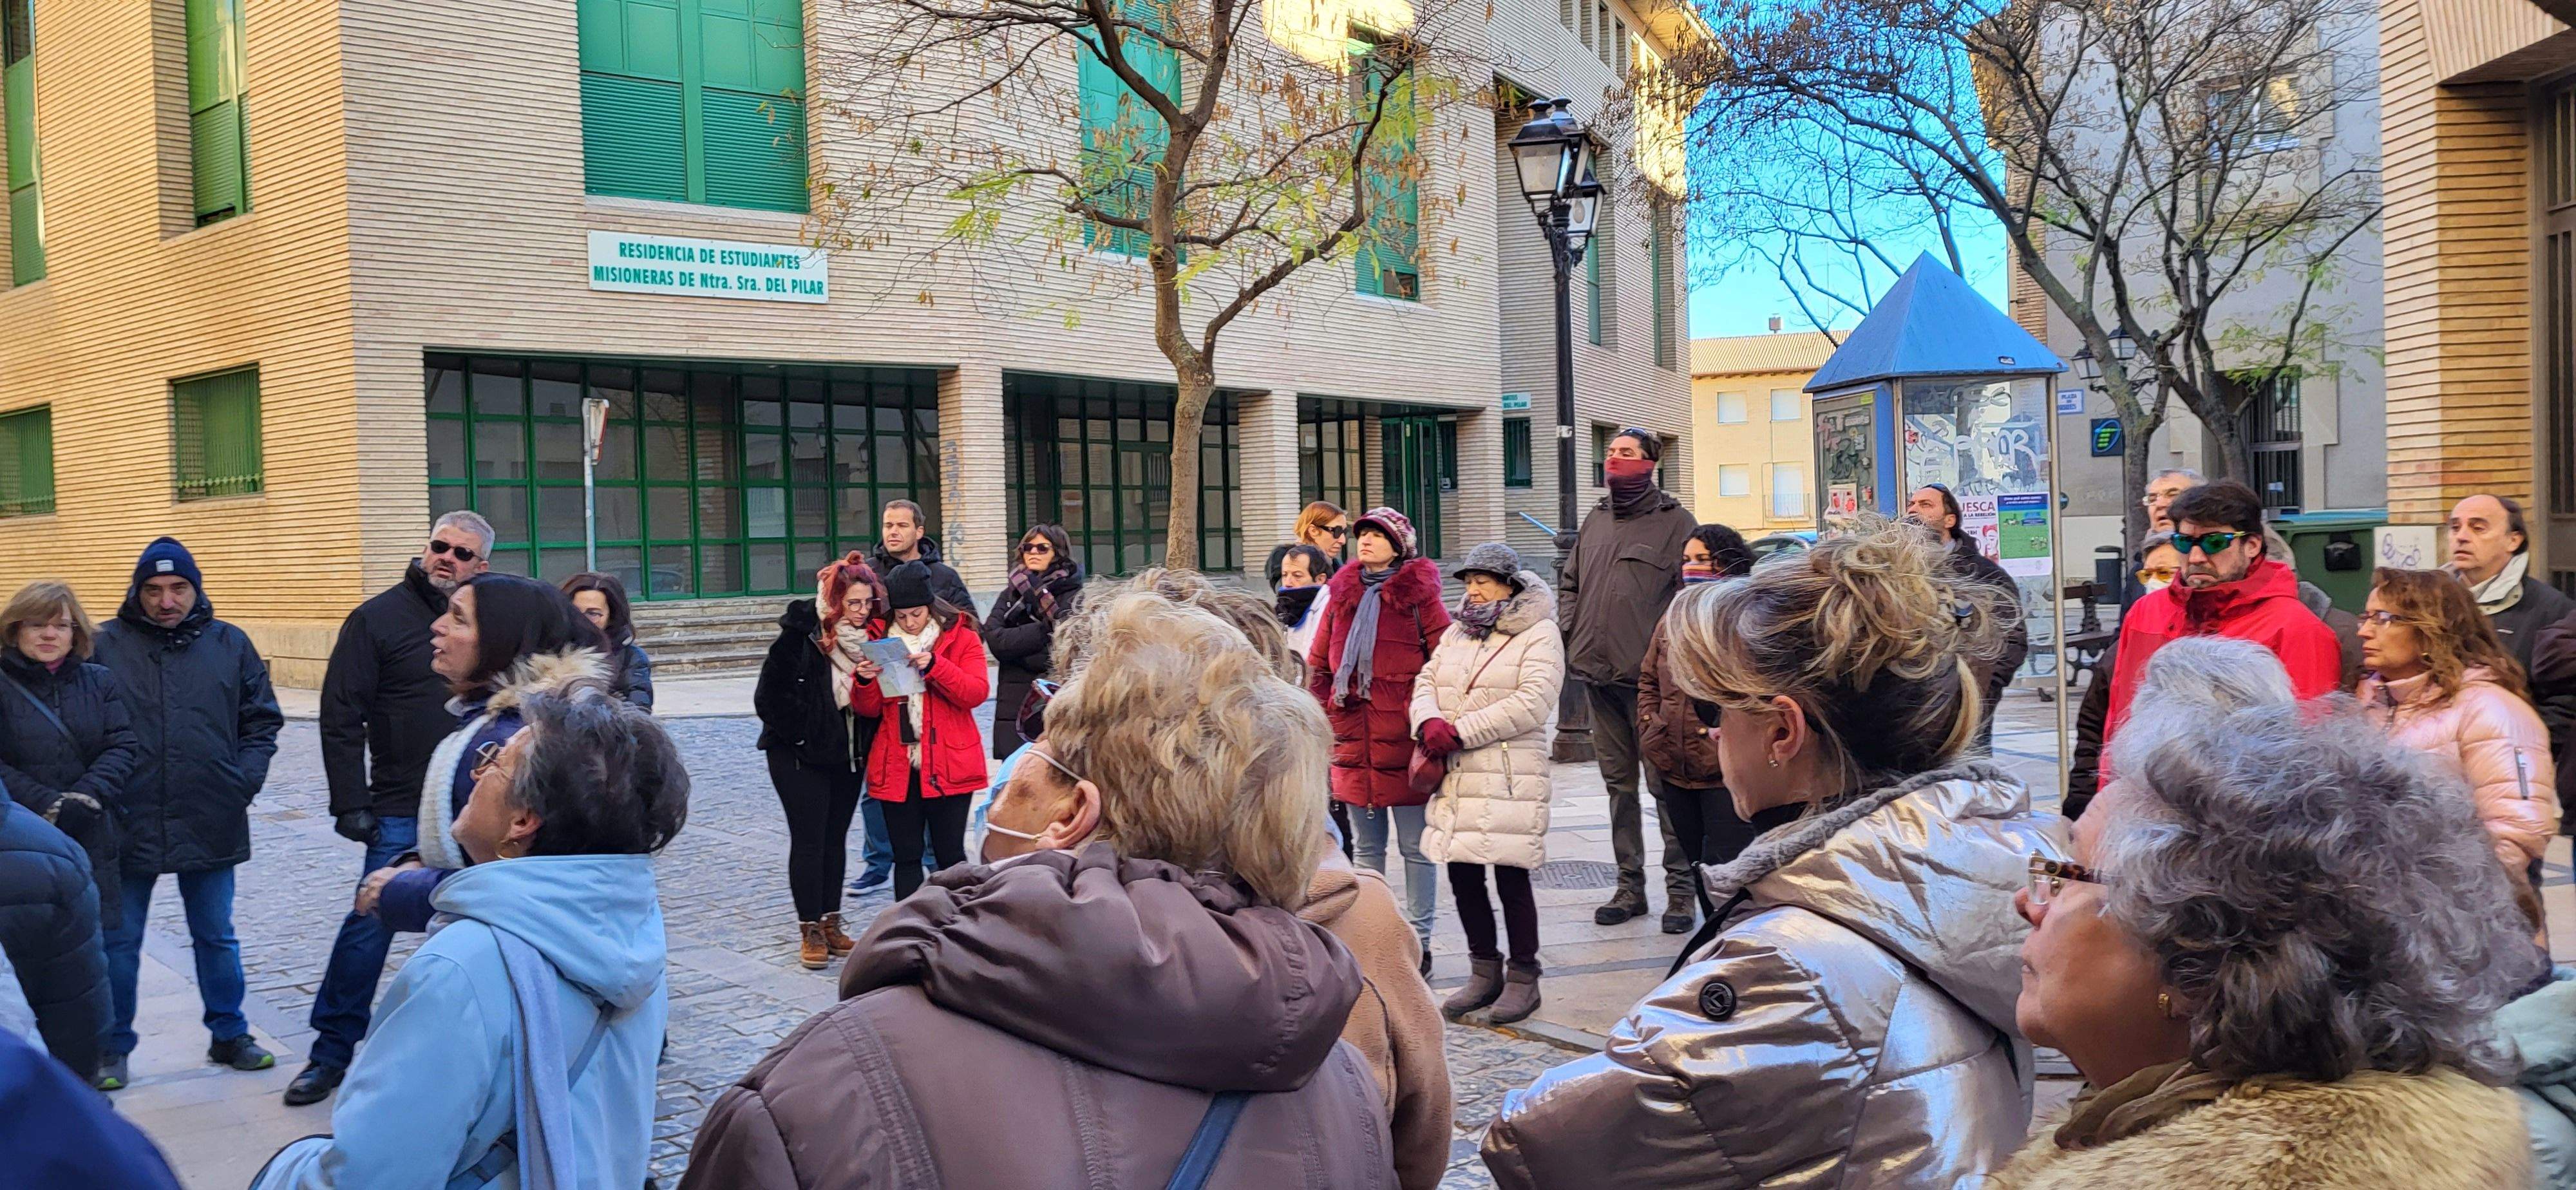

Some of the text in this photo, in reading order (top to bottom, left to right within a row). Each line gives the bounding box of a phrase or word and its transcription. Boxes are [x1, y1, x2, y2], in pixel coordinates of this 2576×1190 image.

[619, 241, 800, 270] RESIDENCIA DE ESTUDIANTES
[593, 265, 824, 296] MISIONERAS DE Ntra. Sra. DEL PILAR
